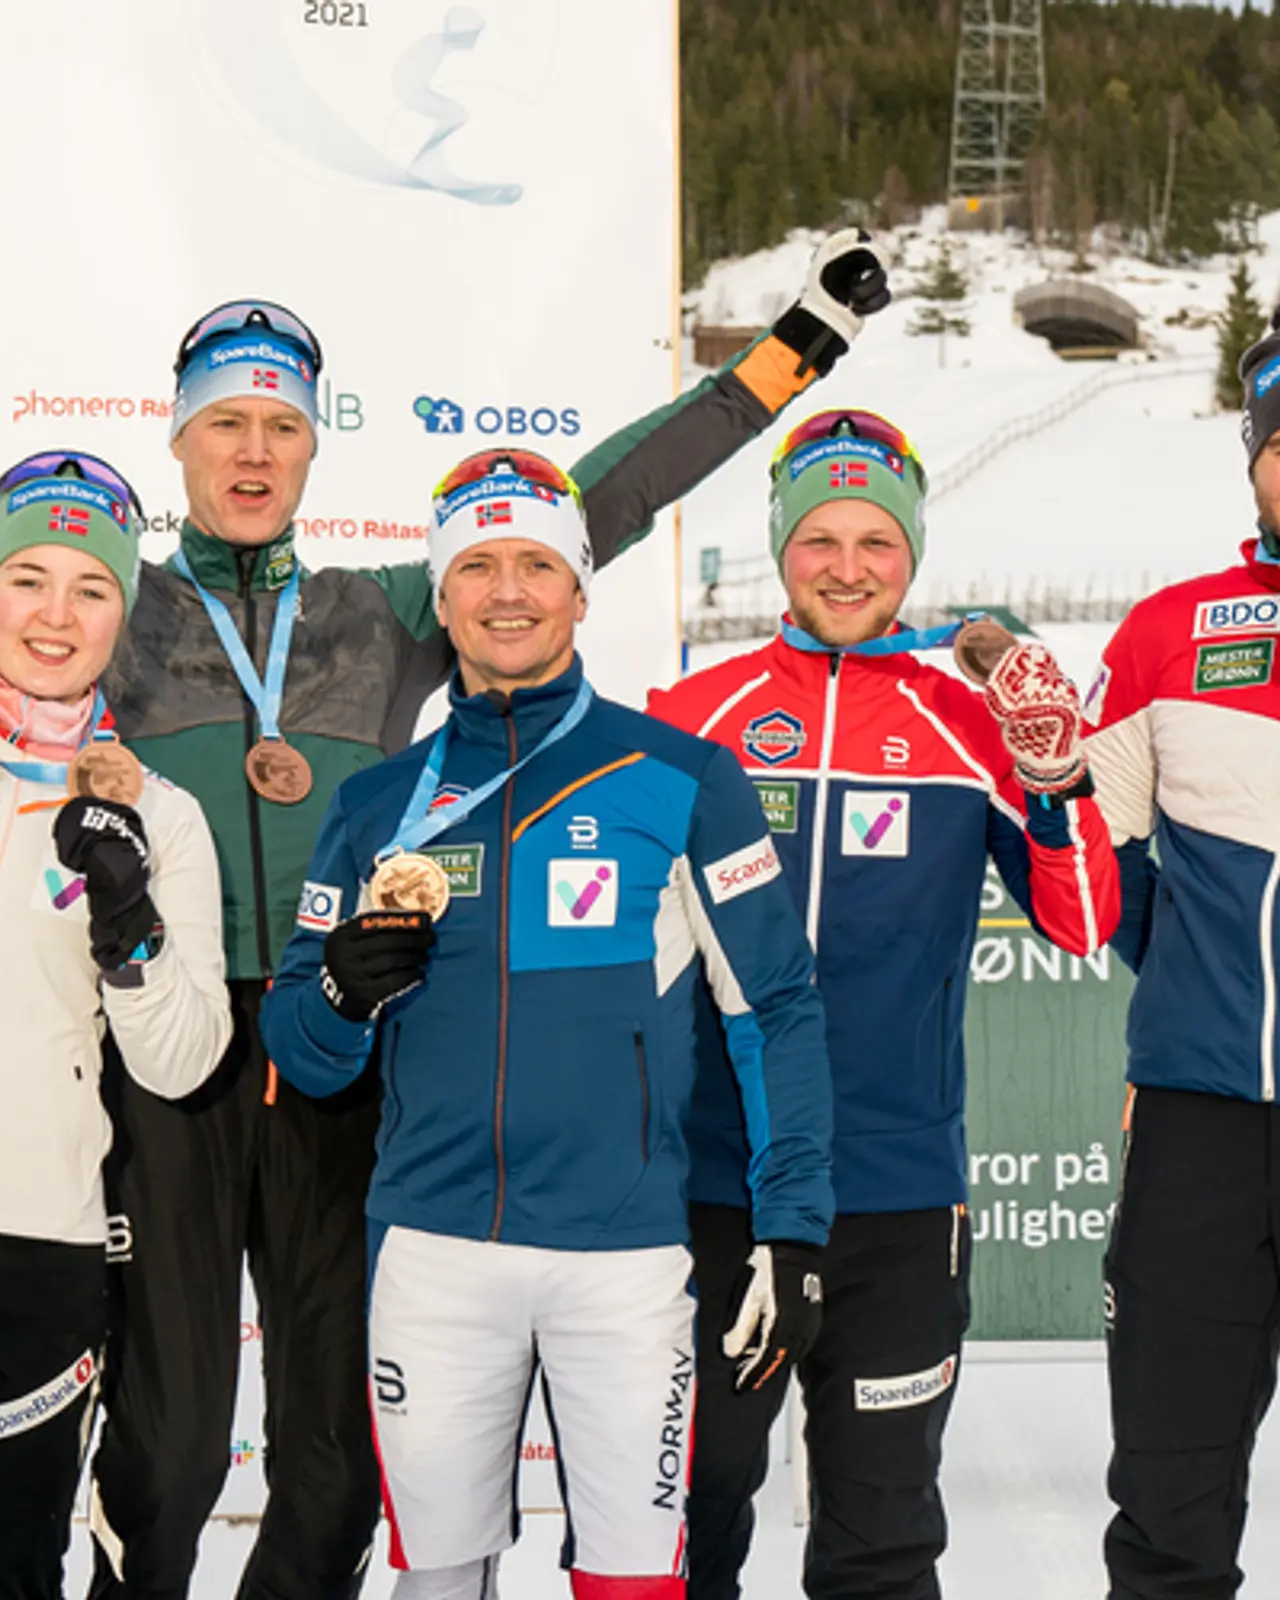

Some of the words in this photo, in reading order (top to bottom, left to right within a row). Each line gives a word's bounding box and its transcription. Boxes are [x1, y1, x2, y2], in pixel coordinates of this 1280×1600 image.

[303, 0, 368, 27] 2021
[12, 388, 136, 423] phonero
[475, 406, 581, 436] OBOS
[1209, 599, 1279, 627] BDO
[1204, 647, 1264, 666] MESTER
[1203, 664, 1262, 684] GRØNN
[1054, 1142, 1110, 1192] på
[651, 1347, 693, 1510] NORWAY
